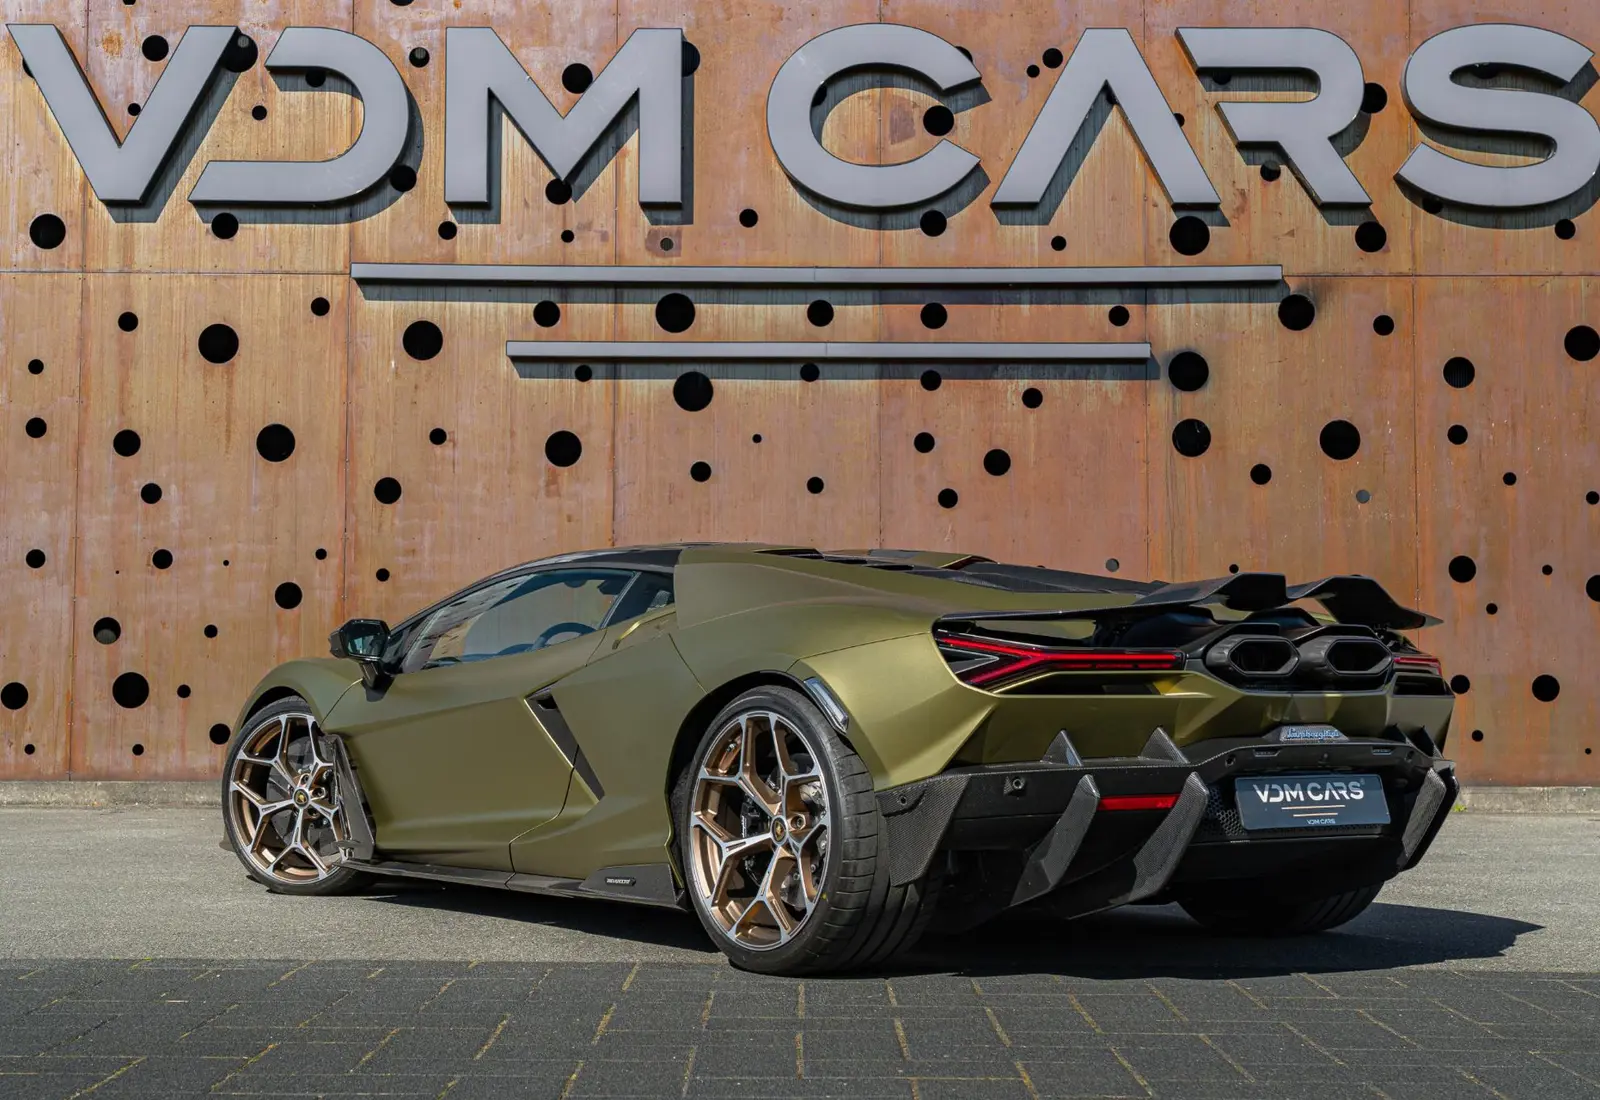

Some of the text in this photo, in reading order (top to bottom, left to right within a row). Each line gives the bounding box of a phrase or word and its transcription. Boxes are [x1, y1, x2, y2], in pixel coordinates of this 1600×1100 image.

[6, 22, 1600, 209] VDM CARS
[1252, 781, 1364, 803] VDM CARS
